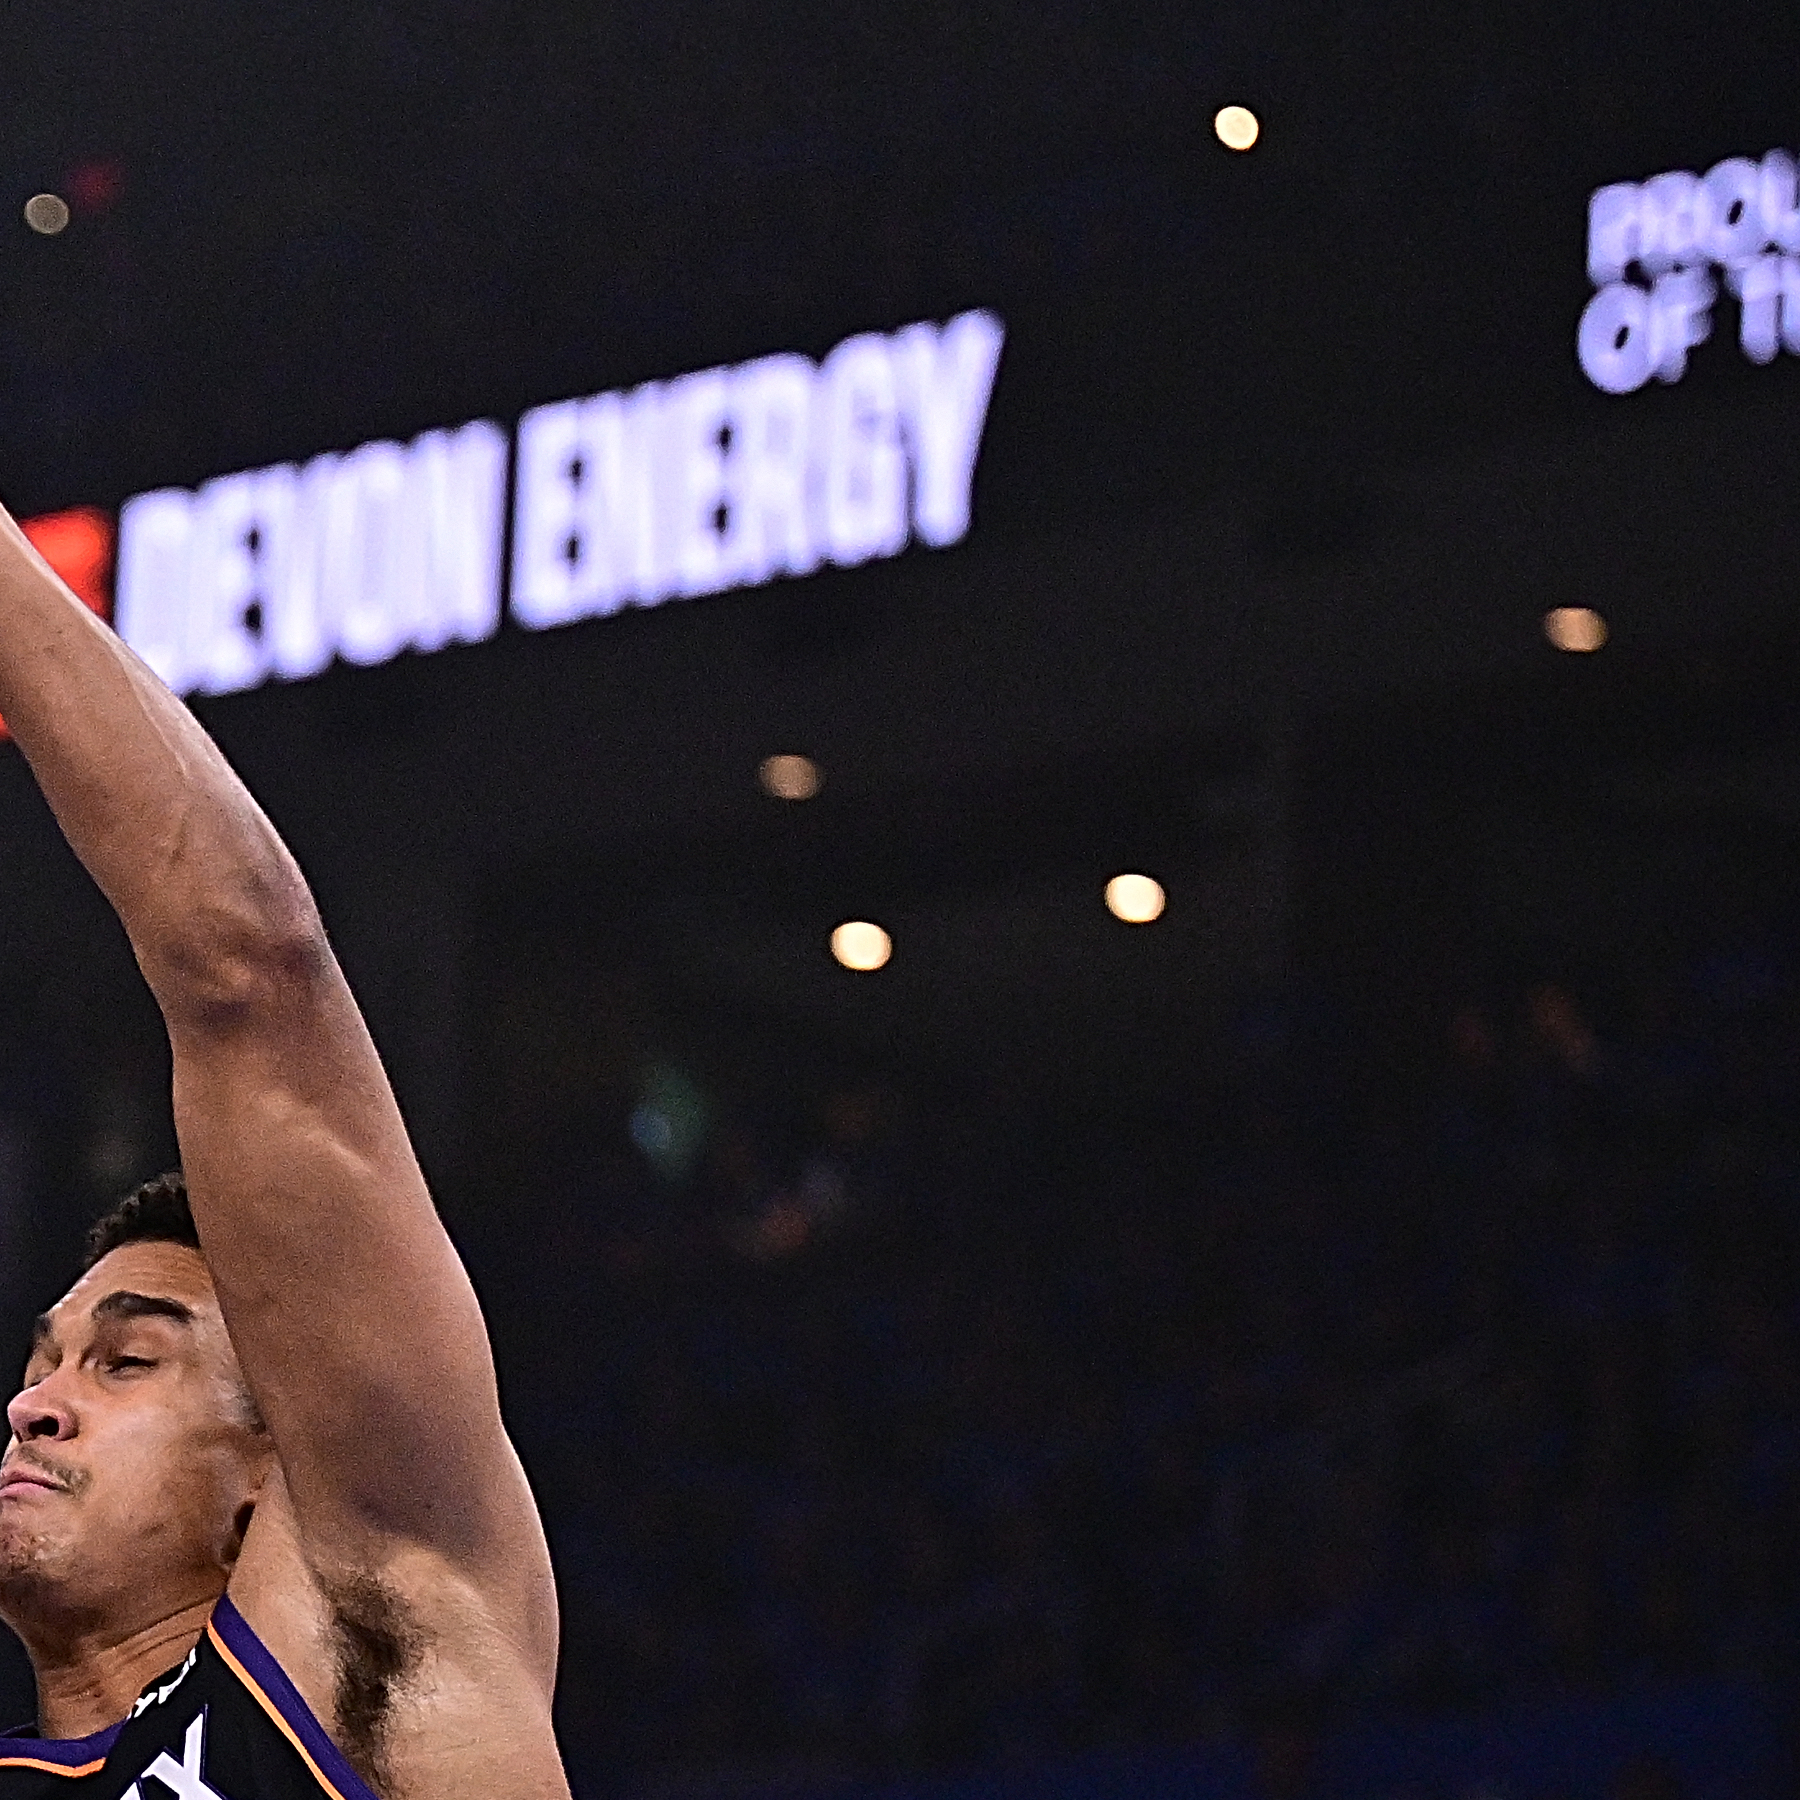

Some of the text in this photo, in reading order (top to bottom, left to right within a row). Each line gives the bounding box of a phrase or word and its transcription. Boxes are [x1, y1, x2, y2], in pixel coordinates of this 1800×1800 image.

[1577, 262, 1717, 395] OF
[115, 306, 1002, 697] DEVON ENERGY
